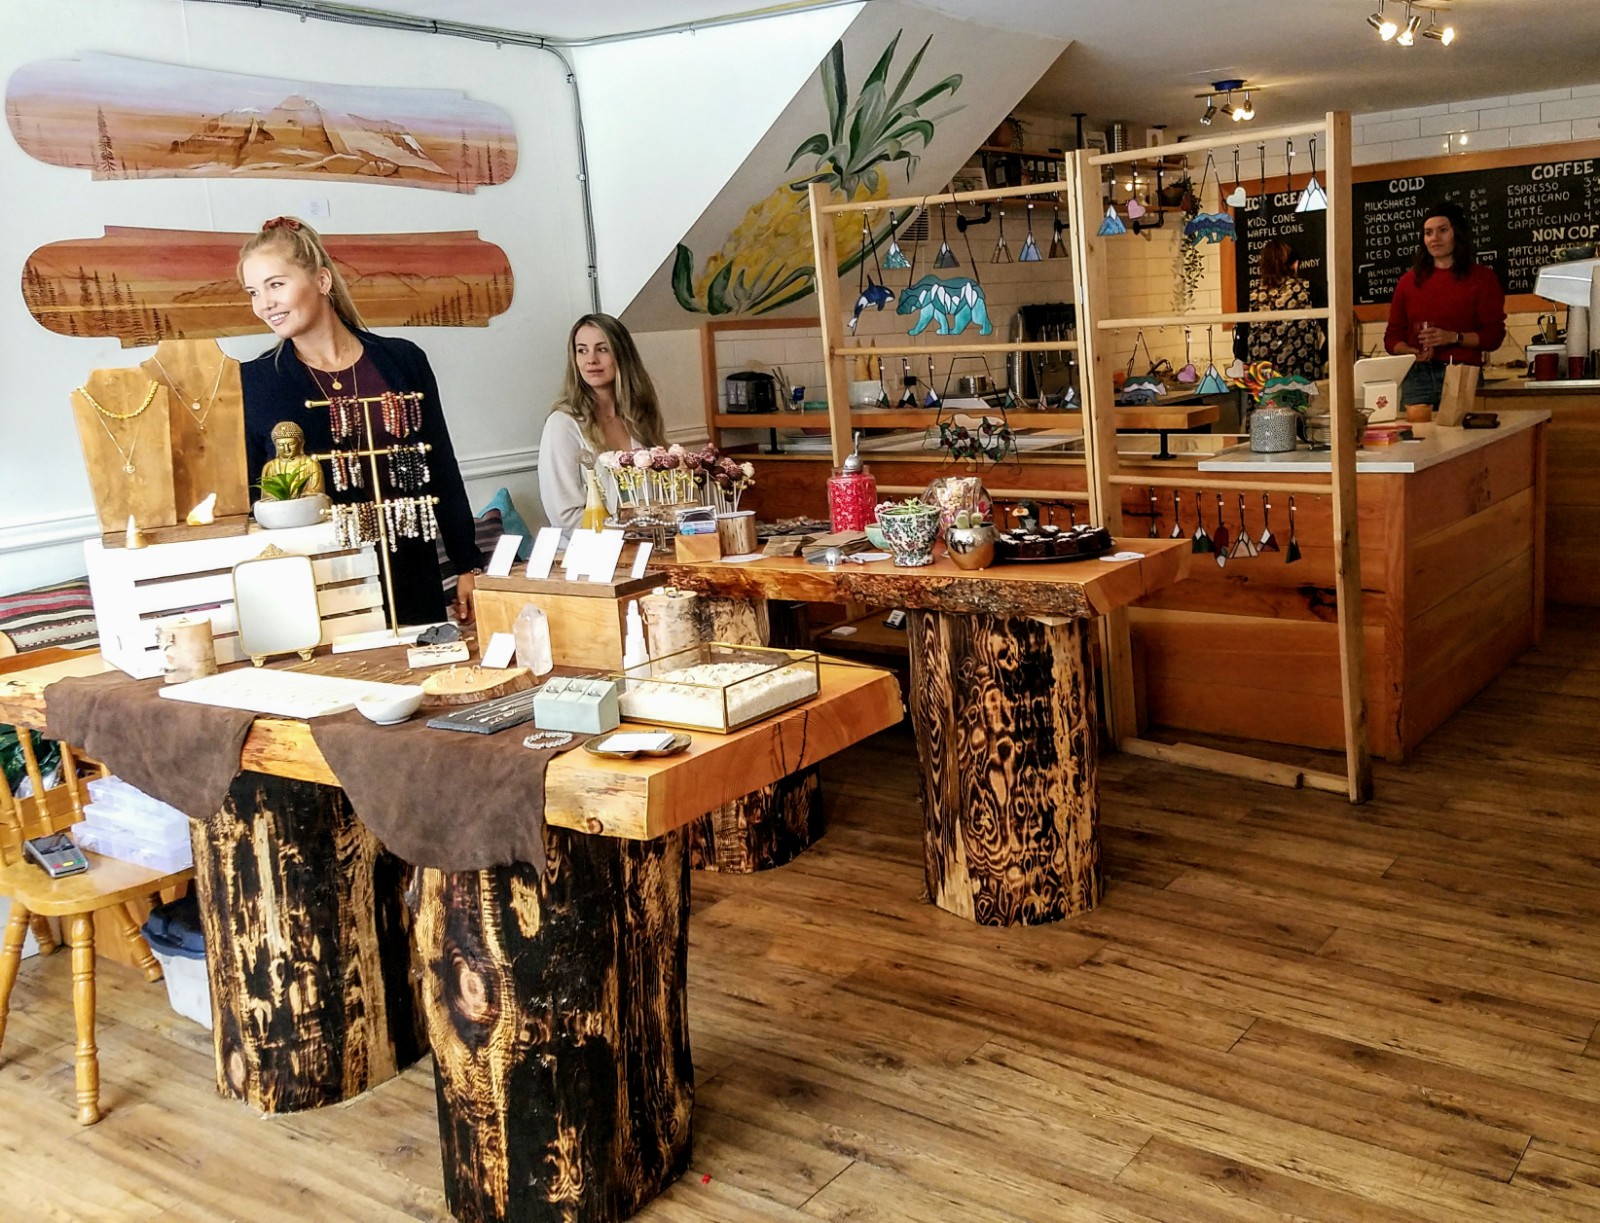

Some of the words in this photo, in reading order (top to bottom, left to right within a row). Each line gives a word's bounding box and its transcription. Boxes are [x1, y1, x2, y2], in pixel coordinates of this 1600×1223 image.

[1531, 160, 1594, 181] COFFEE
[1389, 177, 1425, 193] COLD
[1507, 182, 1559, 196] ESPRESSO
[1364, 196, 1417, 211] MILKSHAKES
[1507, 191, 1570, 206] AMERICANO
[1507, 205, 1544, 219] LATTE
[1247, 216, 1267, 228] KIDS
[1272, 213, 1297, 225] CONE
[1507, 212, 1581, 230] CAPPUCCINO
[1247, 227, 1277, 239] WAFFLE
[1280, 223, 1305, 235] CONE
[1365, 224, 1390, 236] ICED
[1394, 221, 1415, 232] CHAI
[1532, 226, 1565, 242] NON
[1568, 224, 1600, 240] COF
[1365, 236, 1391, 247] ICED
[1396, 231, 1421, 244] LATT
[1365, 249, 1391, 261] ICED
[1396, 244, 1421, 257] COFF
[1508, 244, 1549, 257] MATCHA
[1508, 256, 1551, 267] TUMERIC
[1367, 267, 1401, 278] ALMOND
[1508, 269, 1528, 278] HOT
[1368, 278, 1383, 287] SOY
[1369, 286, 1394, 296] EXTRA
